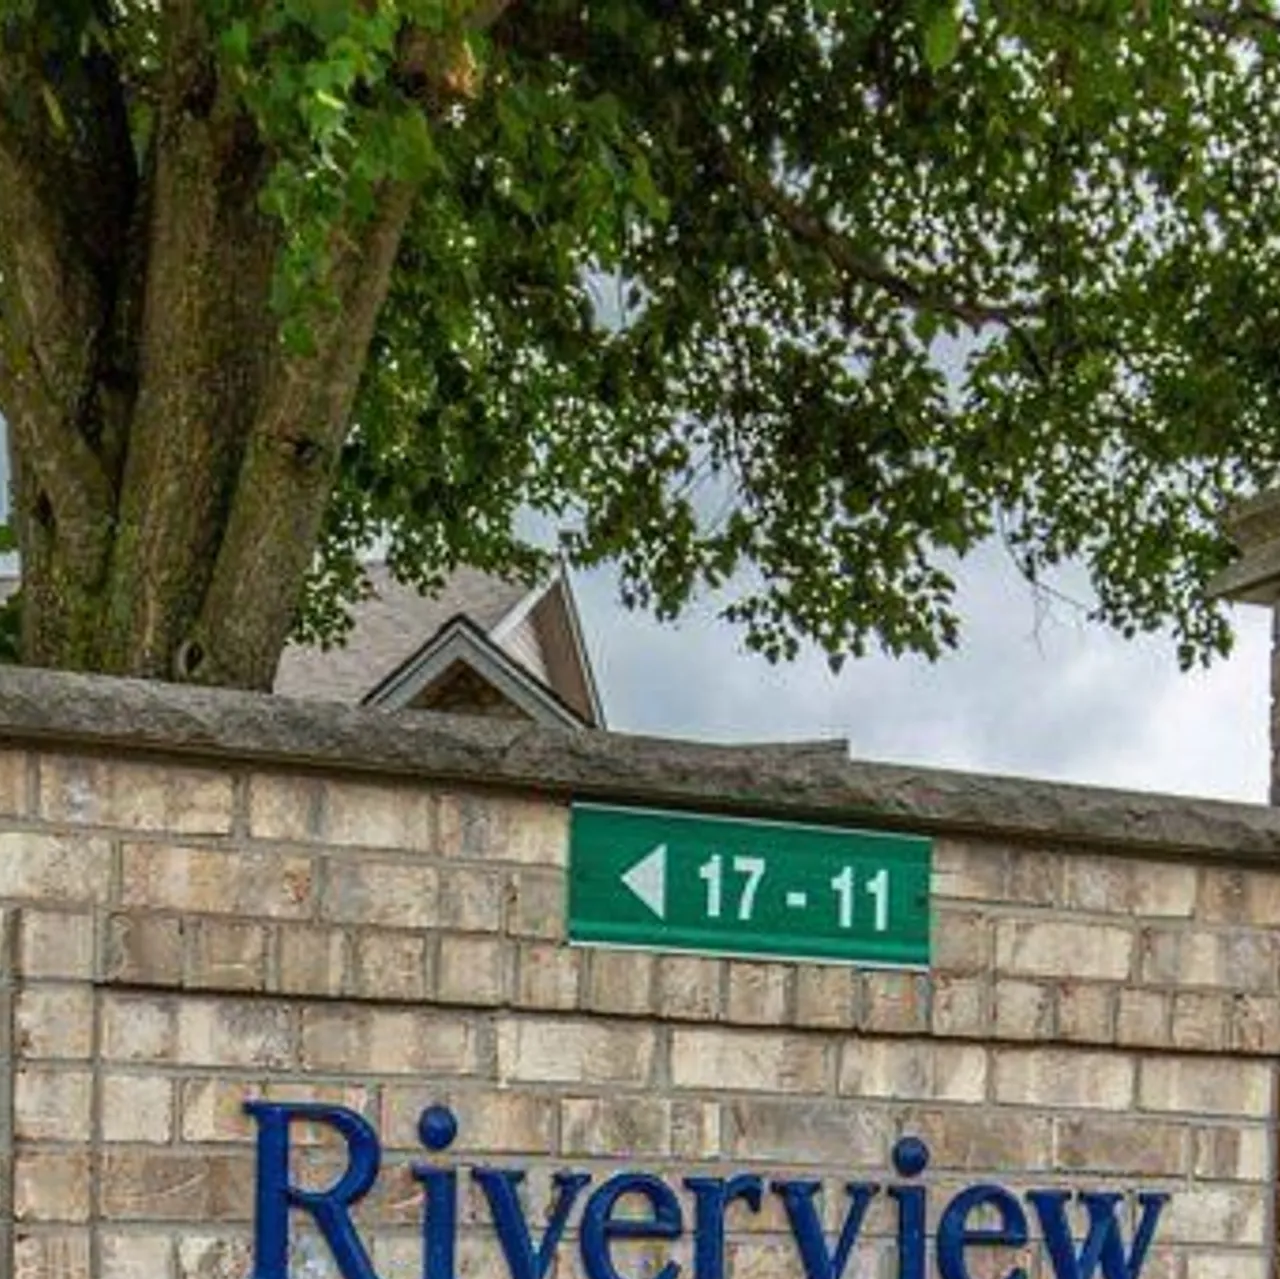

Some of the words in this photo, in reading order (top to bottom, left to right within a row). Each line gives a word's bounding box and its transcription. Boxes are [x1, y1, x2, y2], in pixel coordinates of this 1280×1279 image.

[698, 853, 766, 920] 17
[786, 891, 807, 908] -
[830, 865, 890, 932] 11
